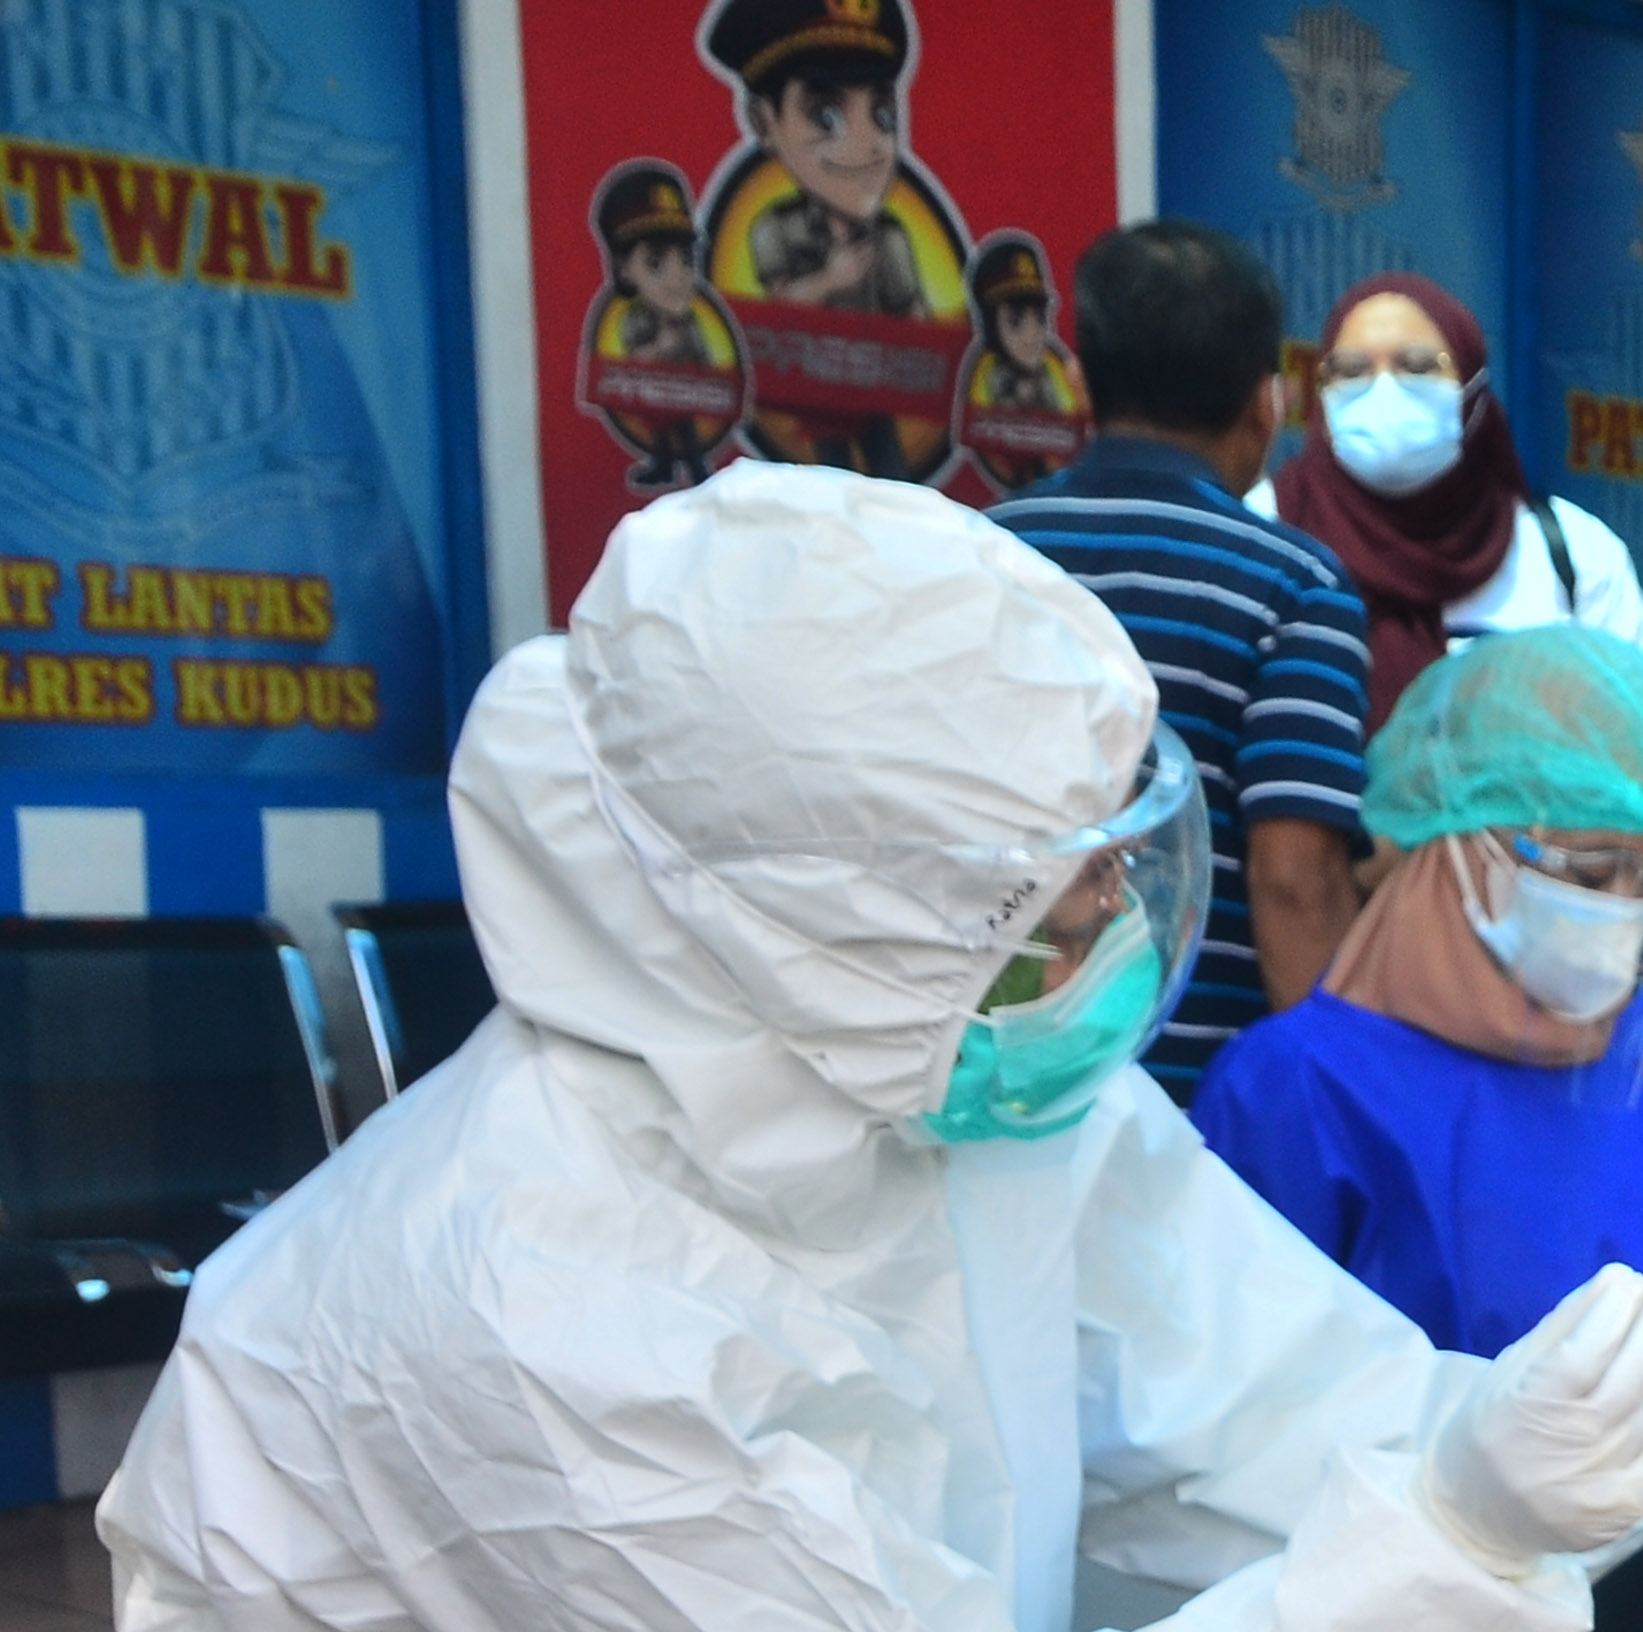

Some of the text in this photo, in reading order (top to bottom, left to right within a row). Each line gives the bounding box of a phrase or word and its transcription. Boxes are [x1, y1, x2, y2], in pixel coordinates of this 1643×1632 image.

[0, 134, 352, 303] TWAL
[78, 561, 333, 644] LANTAS
[172, 655, 380, 732] KUDUS
